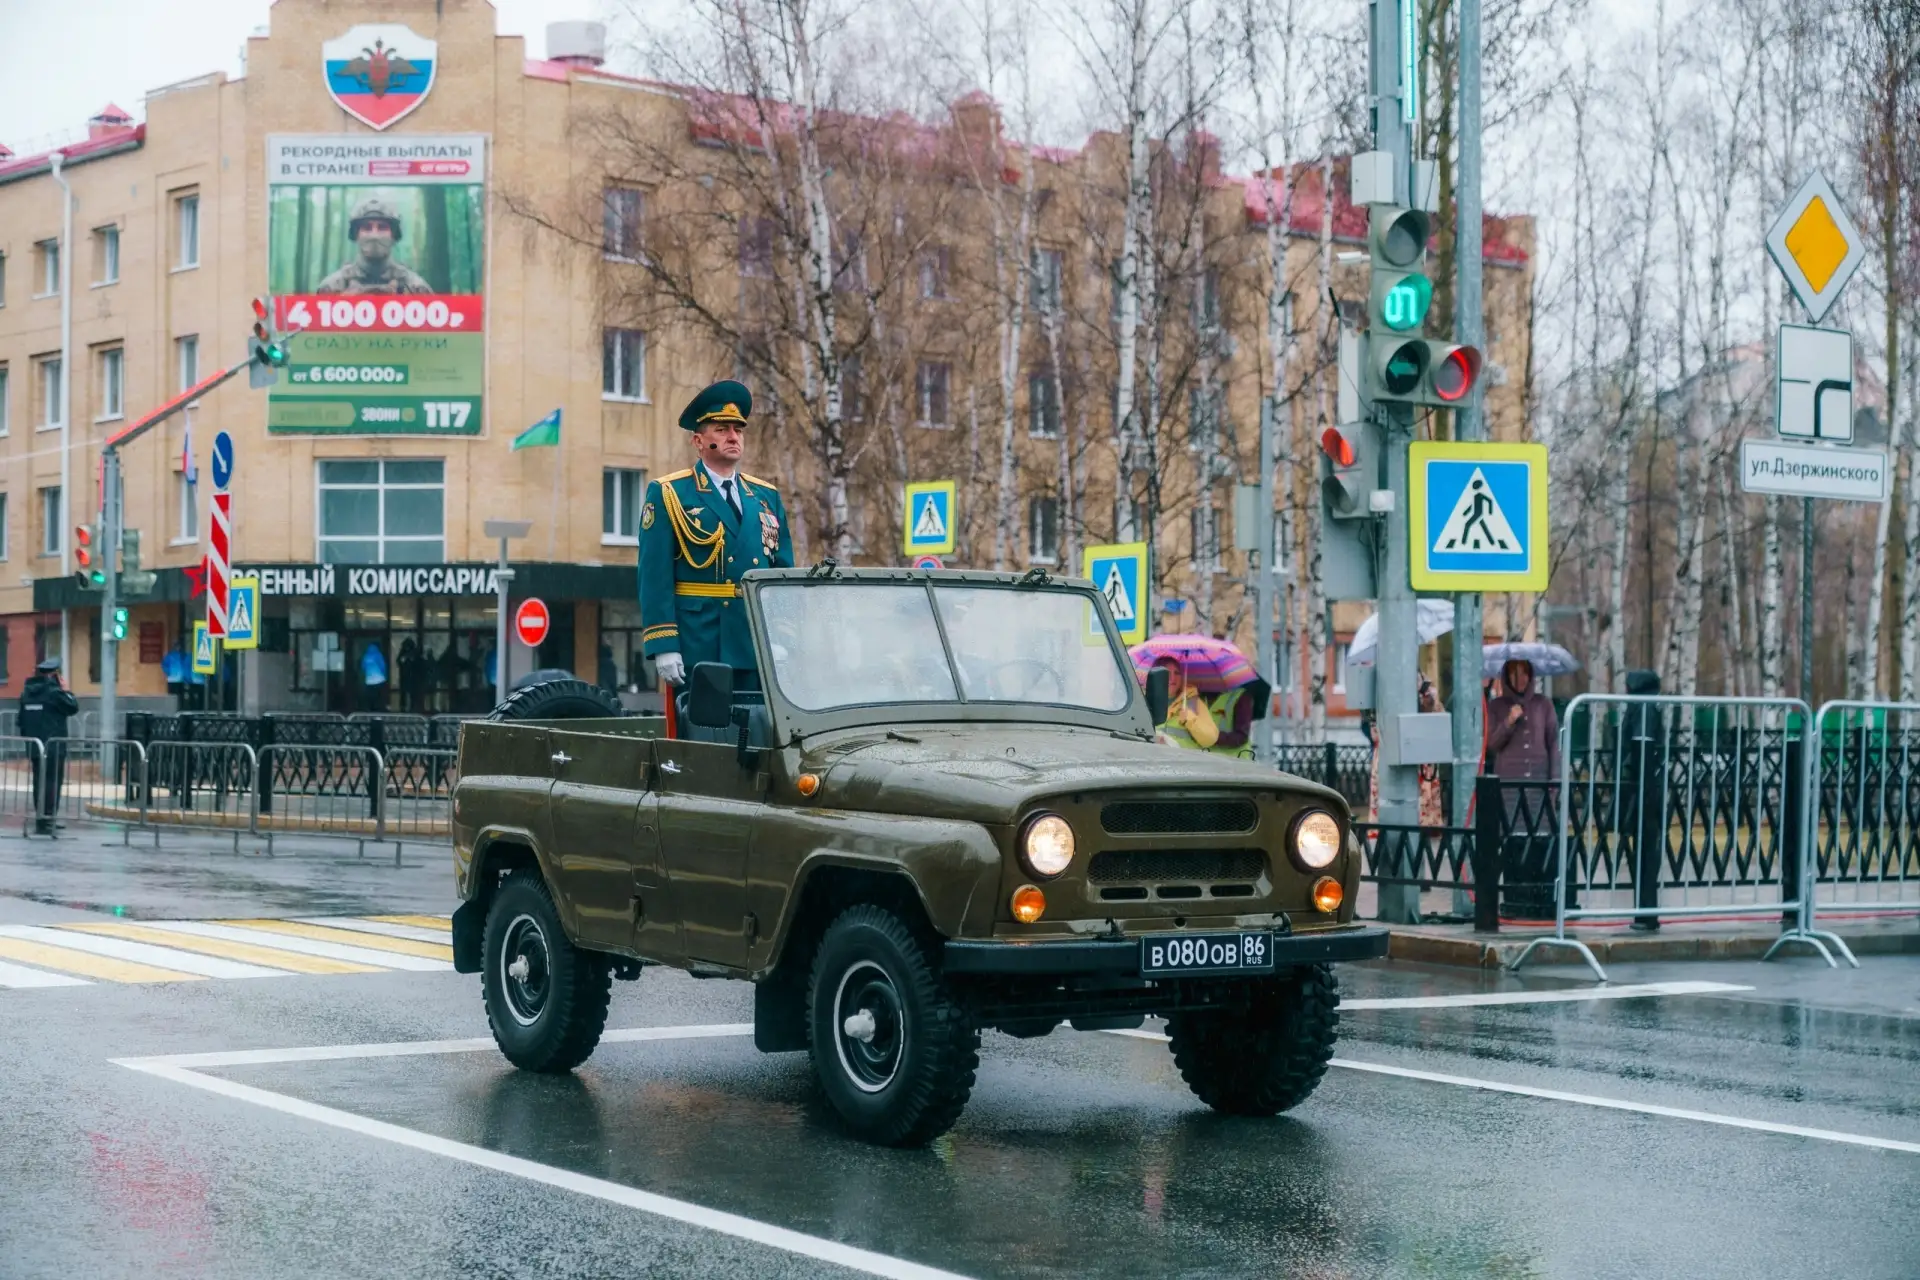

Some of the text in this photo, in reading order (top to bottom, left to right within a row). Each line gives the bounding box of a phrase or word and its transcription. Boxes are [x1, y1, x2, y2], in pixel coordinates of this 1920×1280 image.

[281, 146, 472, 158] РЕКОРДНЫЕ ВЫПЛАТЫ
[281, 163, 291, 175] В
[296, 163, 364, 175] СТРАНЕ!
[287, 301, 312, 327] 4
[317, 300, 376, 327] 100
[304, 337, 448, 350] СРАЗУ НА РУКИ
[310, 366, 322, 382] 6
[323, 366, 358, 382] 600
[361, 407, 400, 422] ЗВОНИ
[423, 402, 471, 428] 117
[1751, 457, 1880, 482] ул.Дзержинского
[348, 567, 500, 595] КОМИССАРИА
[1244, 935, 1265, 956] 86
[1246, 956, 1263, 965] RUS
